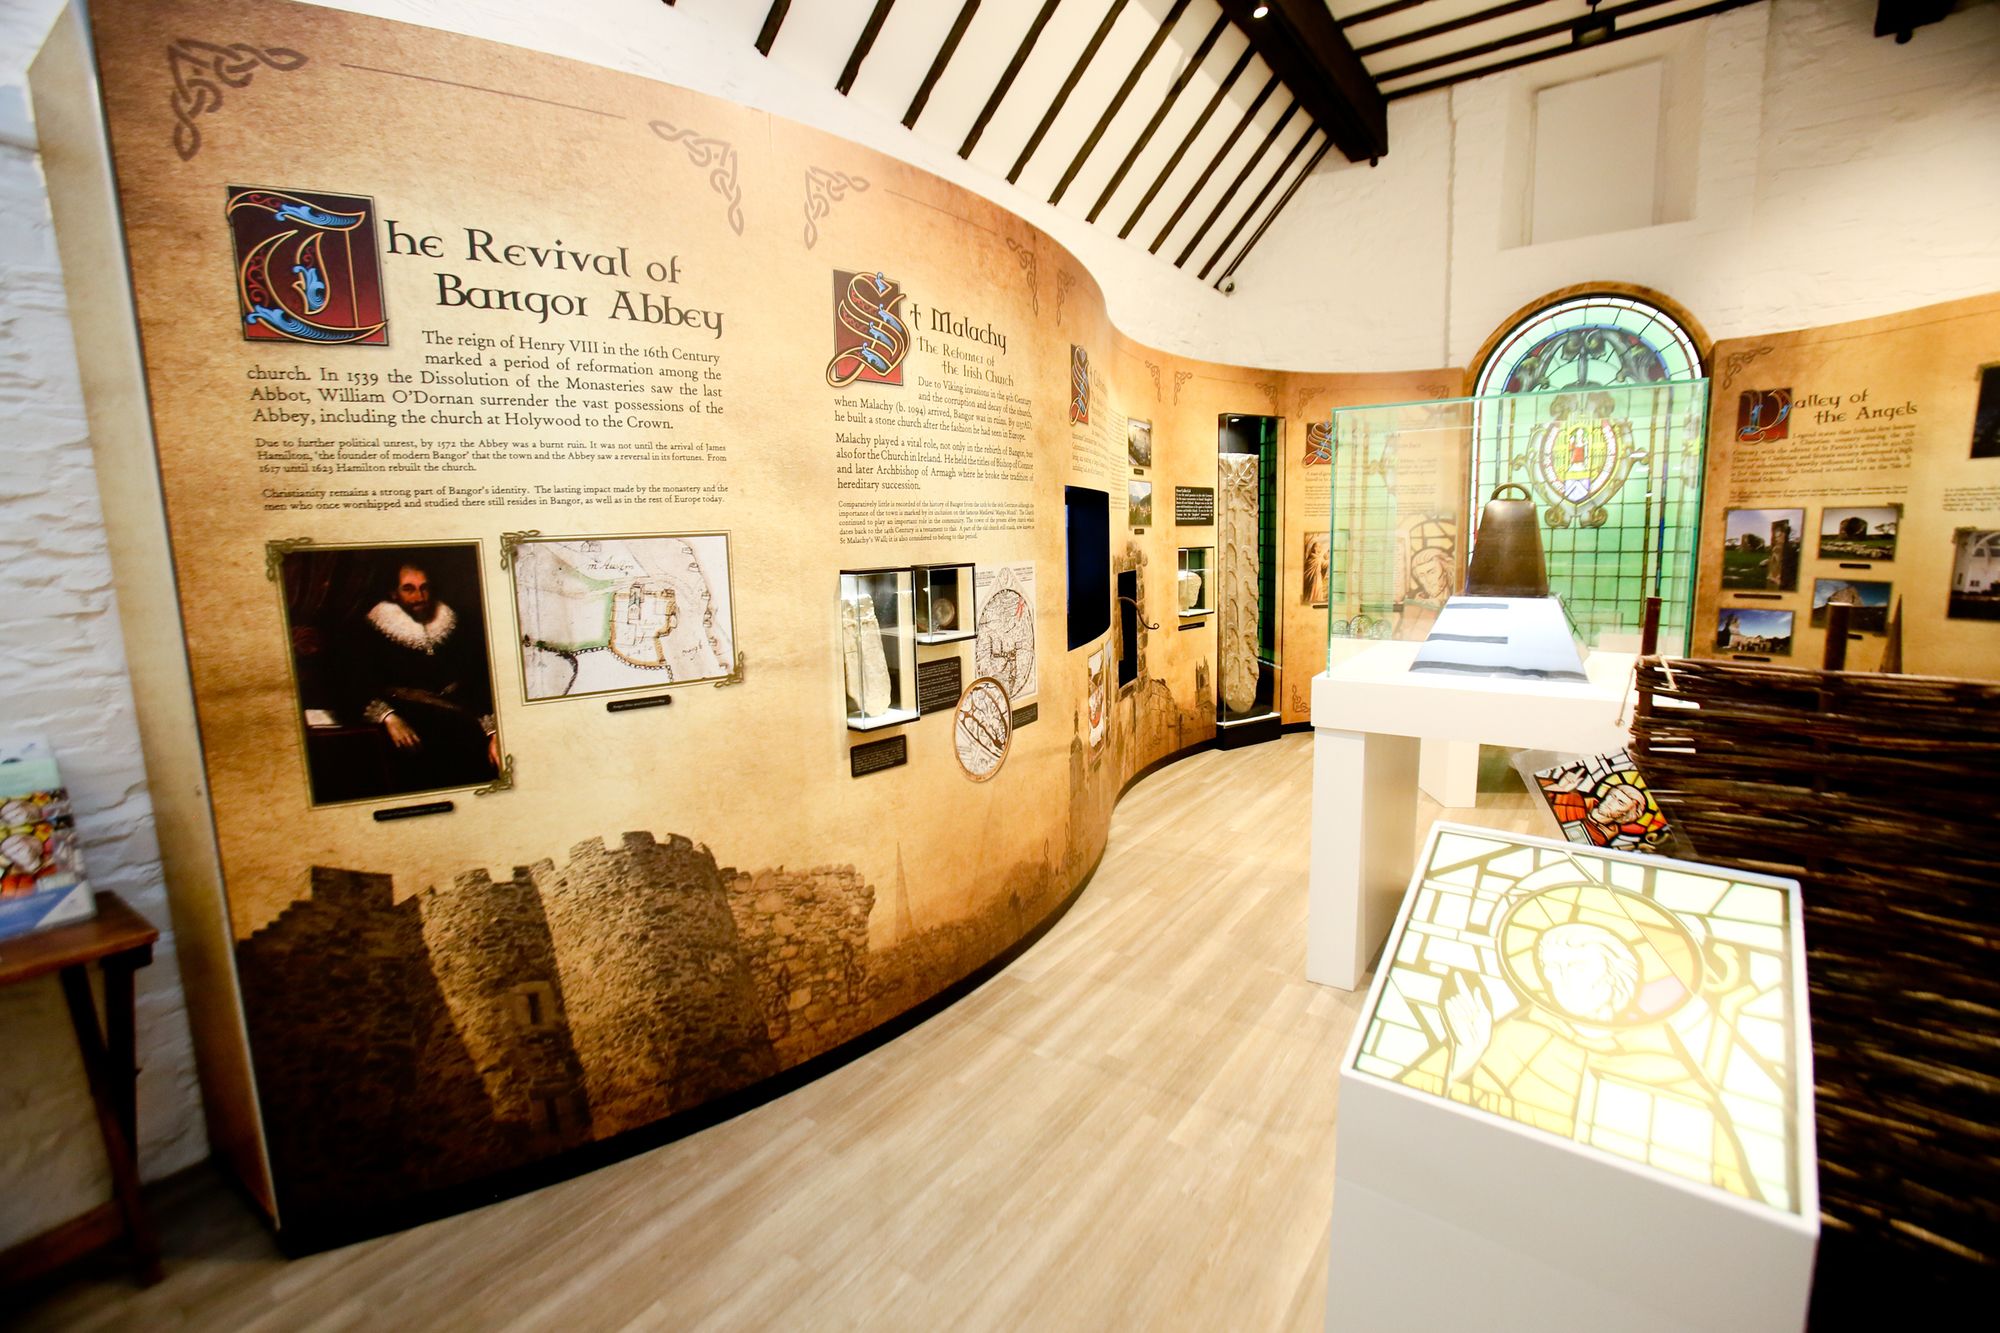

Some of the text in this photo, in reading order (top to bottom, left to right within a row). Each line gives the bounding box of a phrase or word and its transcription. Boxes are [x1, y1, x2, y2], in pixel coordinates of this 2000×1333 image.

[463, 227, 631, 278] Revival
[646, 255, 682, 284] of
[434, 272, 724, 340] Bangor Abbey
[931, 307, 1006, 355] Malachy
[422, 331, 720, 366] The reign of Henry VIII in the 16th Century
[917, 336, 995, 367] The Reformer of
[425, 352, 722, 382] marked a period of reformation among the
[941, 361, 1014, 387] the Irish Church
[247, 365, 722, 397] church. In 1539 the Dissolution of the Monasteries saw the last
[918, 376, 933, 388] Due
[934, 379, 942, 389] to
[943, 379, 964, 395] Viking
[249, 386, 724, 414] Abbot, William O'Dornan surrender the vast possessions of the
[918, 391, 930, 401] and
[932, 392, 943, 403] the
[944, 397, 976, 409] corruption
[976, 400, 986, 410] and
[1848, 388, 1868, 404] of
[253, 408, 674, 431] Abbey, including the church at Holywood to the Crown.
[834, 396, 858, 408] when
[860, 397, 894, 414] Malachy
[896, 401, 906, 414] (b.
[908, 404, 926, 417] 1094)
[927, 406, 952, 419] arrived,
[953, 408, 974, 422] Bangor
[1813, 401, 1919, 425] the Angels
[834, 410, 845, 422] he
[847, 411, 867, 424] built
[875, 415, 896, 426] stone
[897, 416, 922, 428] church
[922, 419, 938, 430] after
[940, 421, 950, 431] the
[950, 422, 972, 433] fashion
[973, 424, 980, 434] he
[255, 437, 279, 447] Due
[282, 439, 294, 447] to
[297, 438, 335, 447] further
[338, 438, 380, 450] political
[420, 438, 433, 450] by
[437, 441, 456, 450] 1572
[460, 439, 475, 448] the
[478, 439, 508, 451] Abbey
[539, 439, 564, 449] burnt
[567, 440, 587, 449] ruin.
[590, 440, 597, 449] It
[618, 442, 632, 450] not
[634, 441, 653, 450] until
[655, 441, 668, 450] the
[670, 442, 694, 451] arrival
[695, 442, 704, 451] of
[705, 442, 726, 452] James
[835, 432, 871, 448] Malachy
[874, 435, 899, 449] played
[906, 438, 922, 448] vital
[924, 438, 938, 450] role,
[952, 441, 966, 454] only
[836, 448, 853, 459] also
[854, 448, 866, 459] for
[880, 450, 910, 461] Church
[910, 452, 917, 462] in
[918, 452, 942, 463] Ireland.
[944, 453, 954, 463] He
[260, 463, 281, 476] 1617
[312, 463, 333, 475] 1623
[337, 463, 386, 472] Hamilton
[388, 463, 421, 472] rebuilt
[424, 463, 439, 472] the
[441, 462, 477, 472] church.
[836, 463, 853, 474] and
[855, 463, 874, 474] later
[876, 464, 919, 479] Archbishop
[921, 466, 929, 476] of
[930, 466, 956, 480] Armagh
[957, 468, 976, 478] where
[976, 469, 983, 479] he
[837, 478, 920, 492] hereditary succession.
